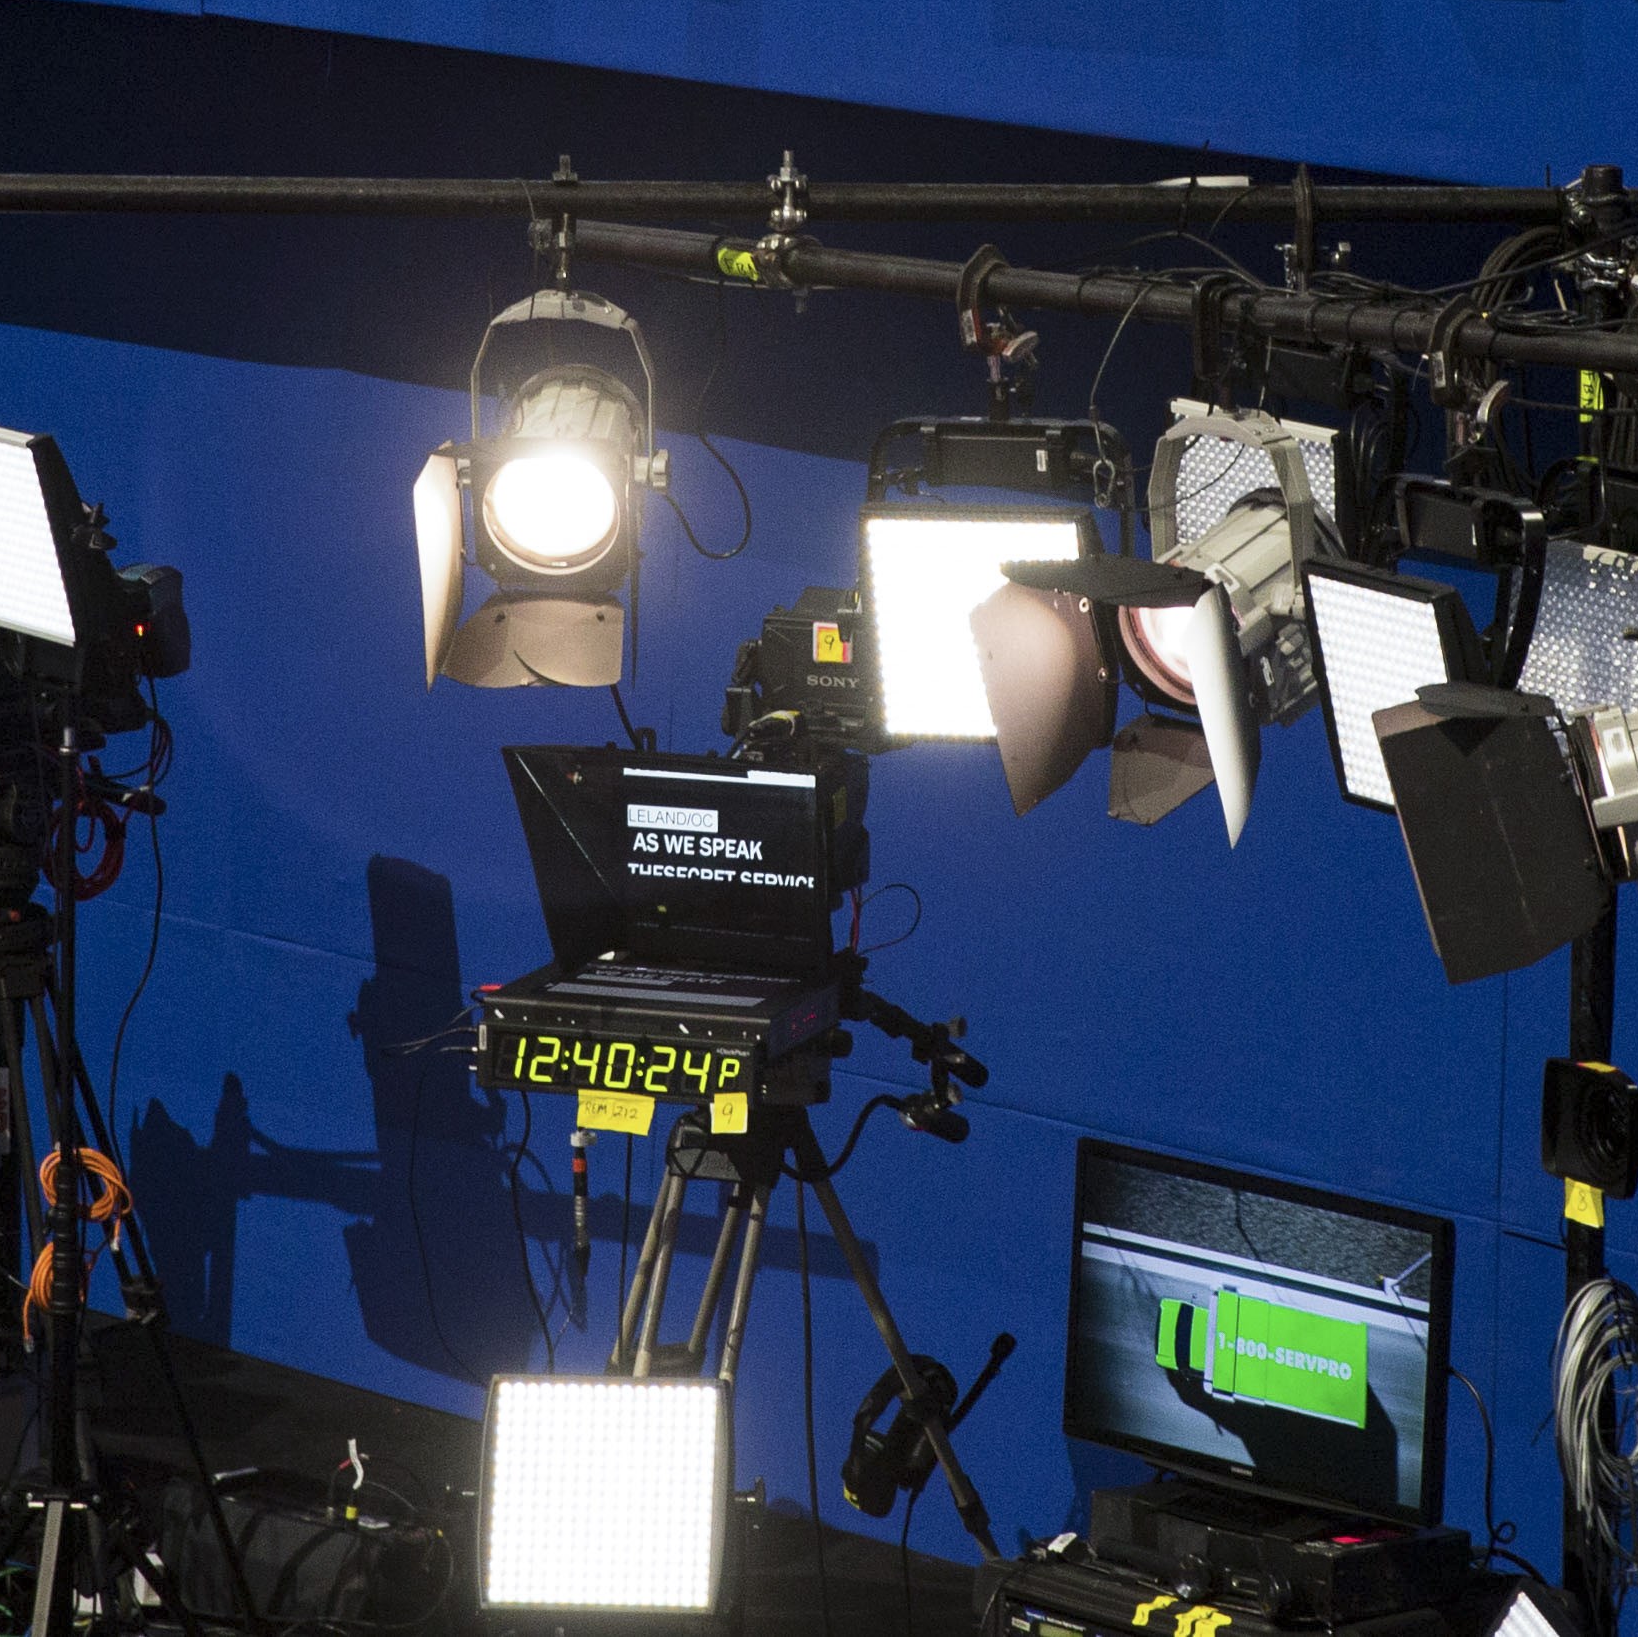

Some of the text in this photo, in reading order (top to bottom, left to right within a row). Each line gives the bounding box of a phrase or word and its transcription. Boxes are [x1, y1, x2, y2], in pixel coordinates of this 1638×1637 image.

[806, 674, 860, 689] SONY
[632, 832, 764, 861] AS WE SPEAK
[1217, 1331, 1354, 1381] 1-800-SERVPRO
